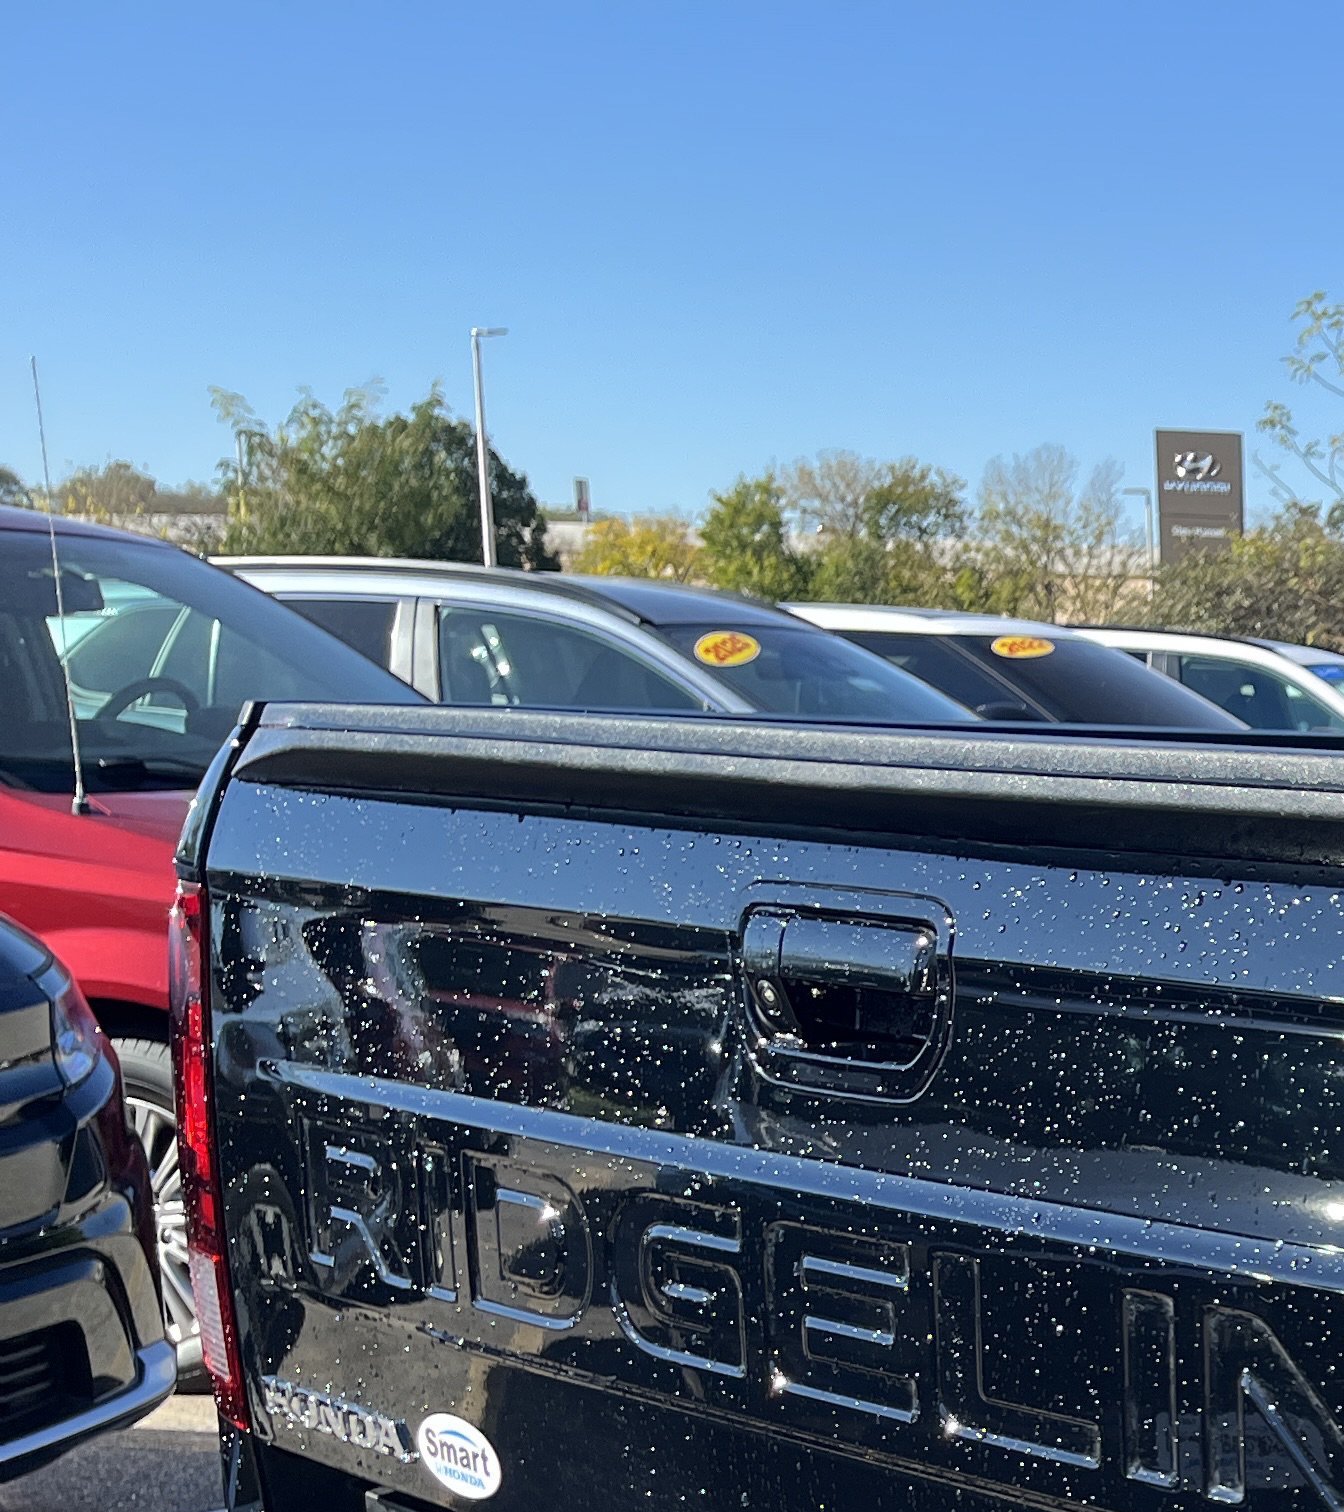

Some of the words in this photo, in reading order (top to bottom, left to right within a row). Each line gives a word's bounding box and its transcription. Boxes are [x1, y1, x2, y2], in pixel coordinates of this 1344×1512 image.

[262, 1376, 416, 1463] HONDA
[425, 1427, 491, 1477] Smart
[444, 1466, 486, 1490] HONDA
